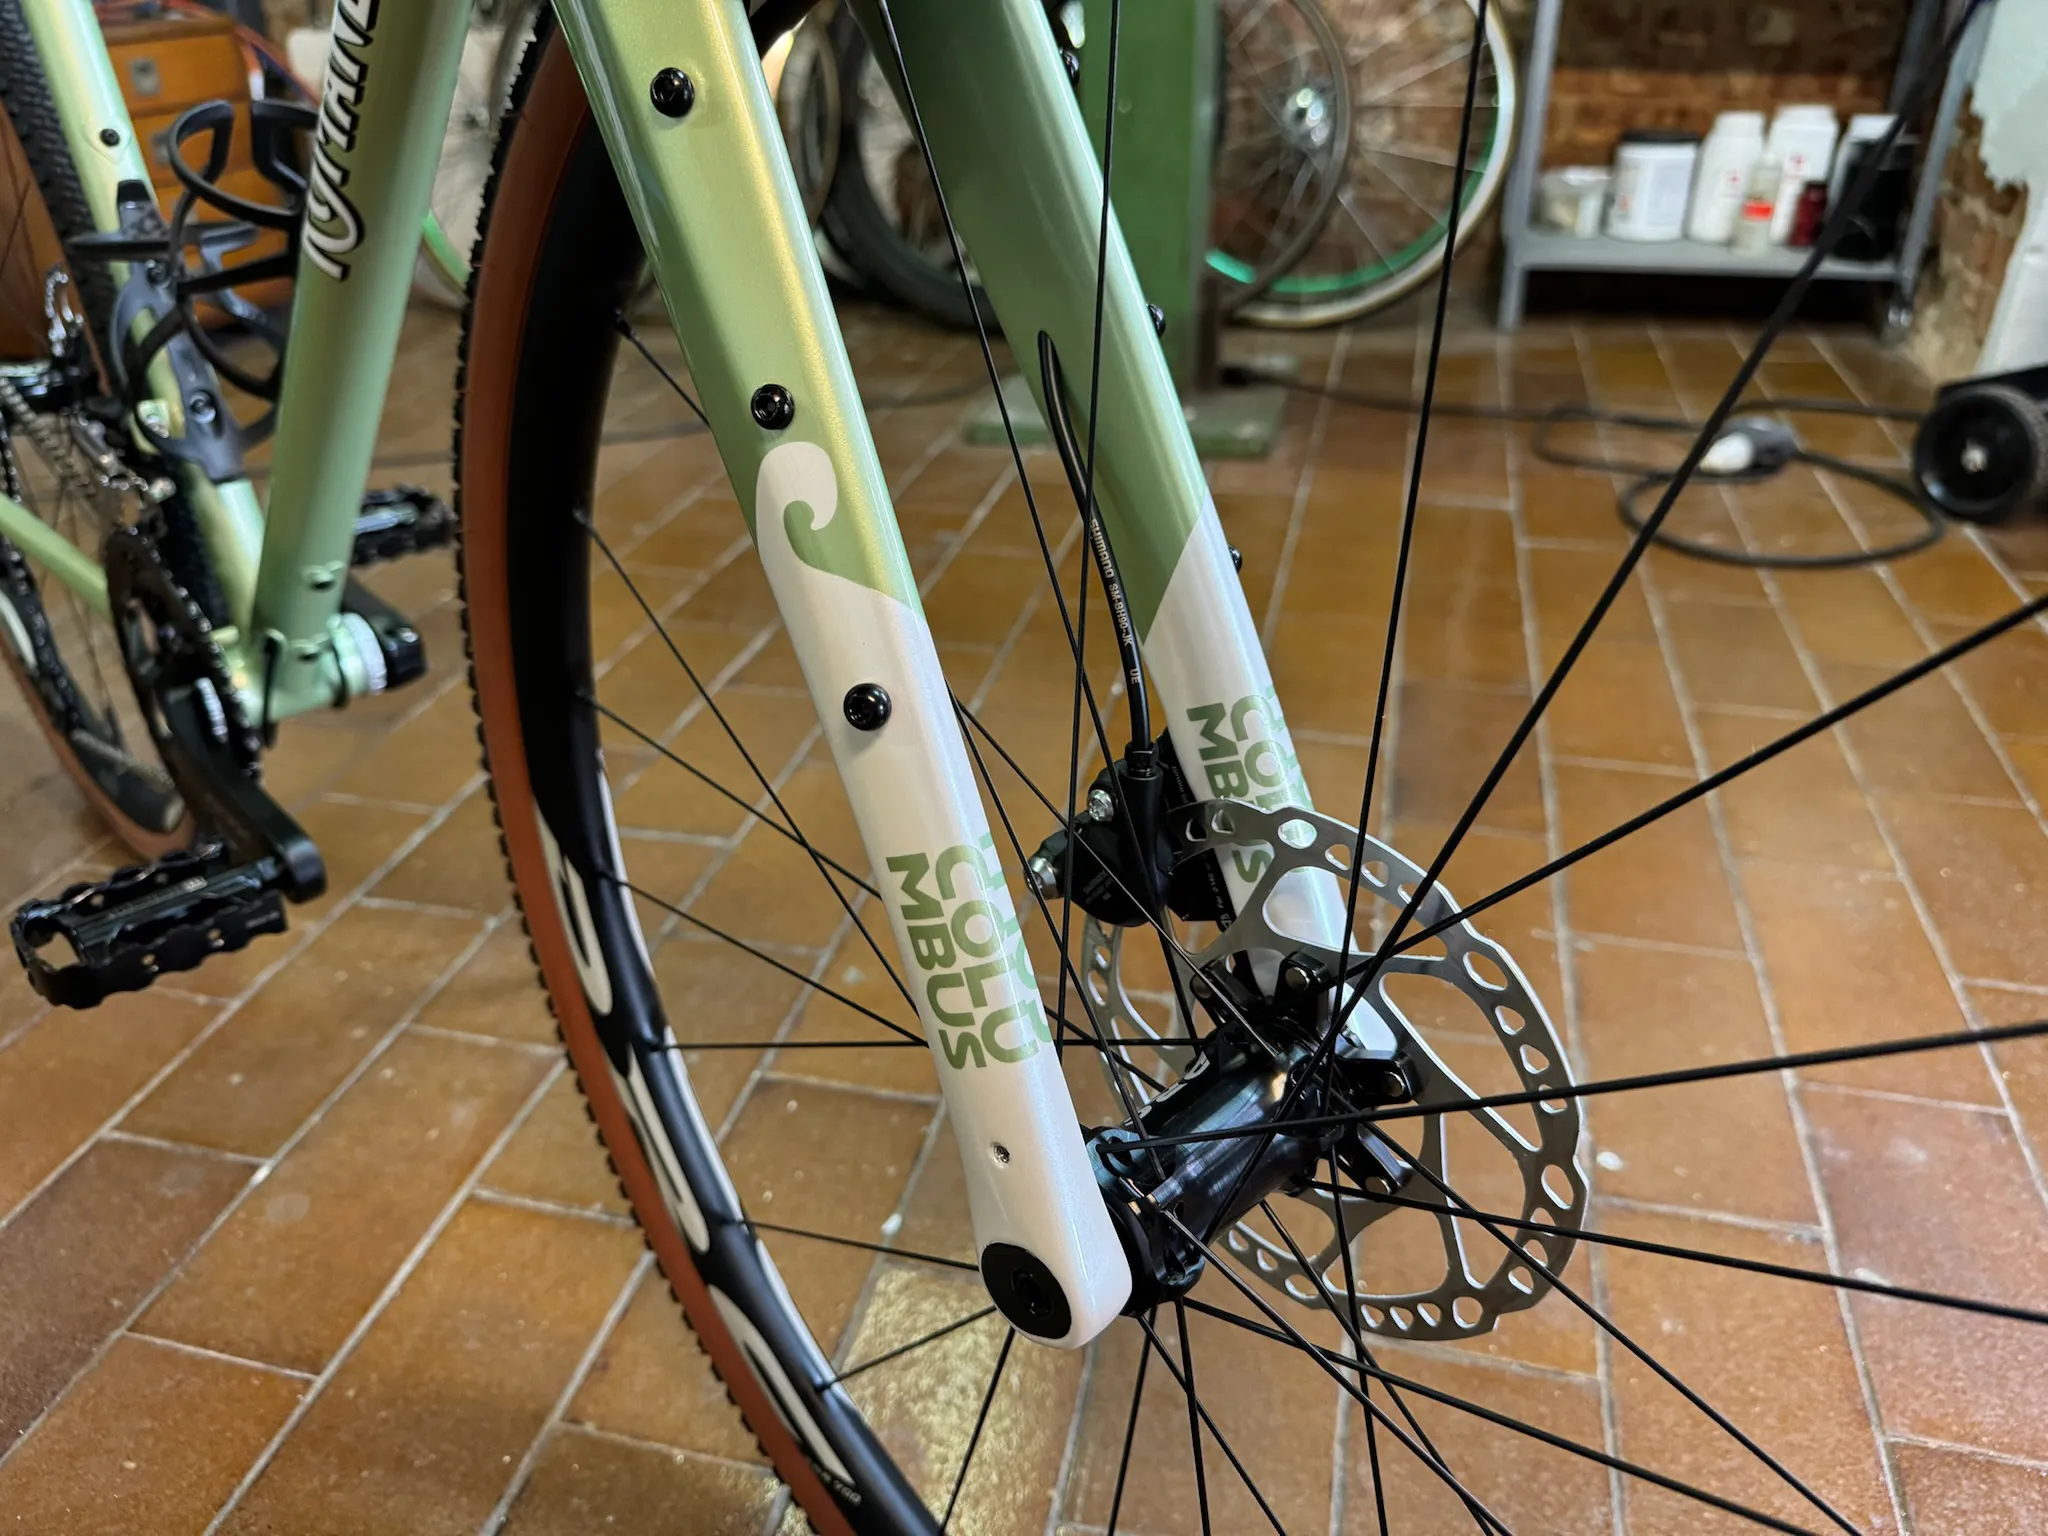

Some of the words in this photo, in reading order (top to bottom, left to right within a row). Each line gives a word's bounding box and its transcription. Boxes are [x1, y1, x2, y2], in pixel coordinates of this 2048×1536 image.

[1090, 518, 1115, 579] SHIMANO
[1108, 582, 1133, 647] SM-BH90-JK
[1186, 702, 1273, 883] MBS
[885, 852, 987, 1070] MBUS
[935, 844, 1039, 1064] COLU
